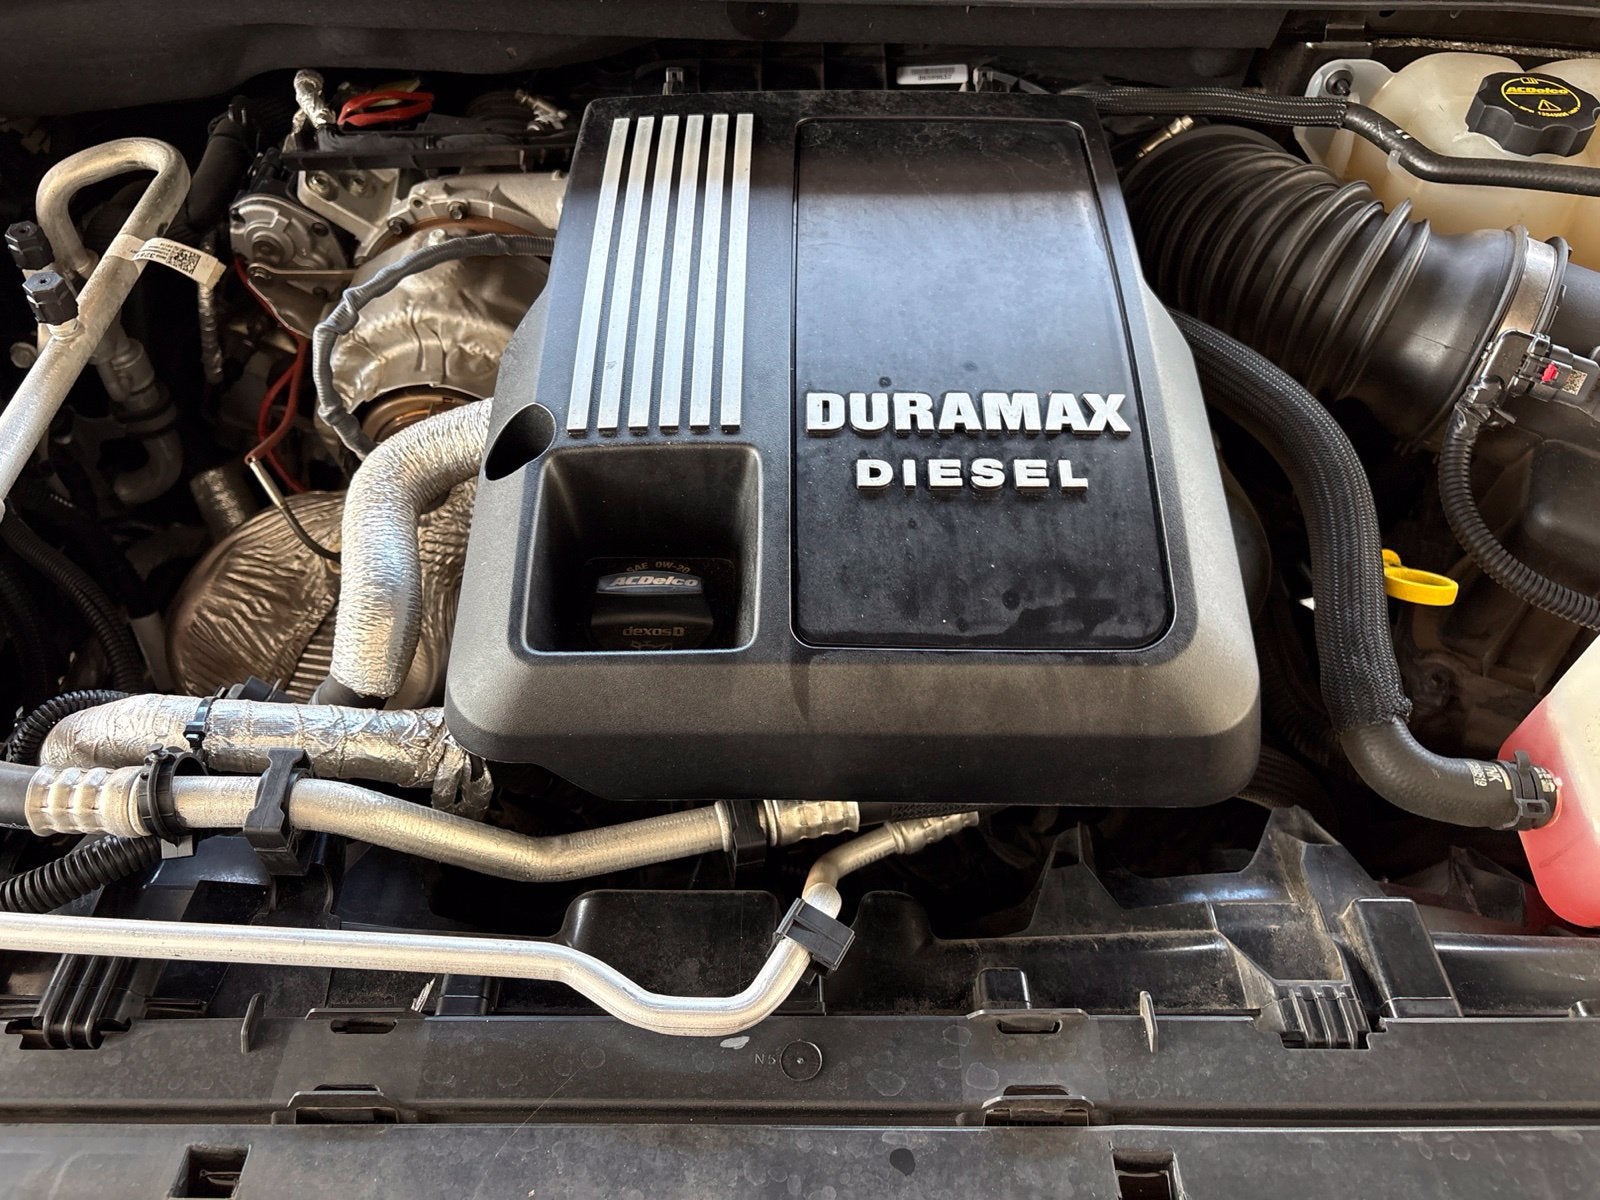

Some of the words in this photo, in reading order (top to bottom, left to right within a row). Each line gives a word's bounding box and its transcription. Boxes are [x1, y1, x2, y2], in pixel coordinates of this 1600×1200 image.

[1505, 86, 1569, 95] ACDelco
[805, 392, 1132, 435] DURAMAX
[856, 458, 1089, 490] DIESEL
[626, 562, 649, 573] SAE
[655, 561, 691, 574] 0W-20
[609, 576, 699, 587] ACDelco
